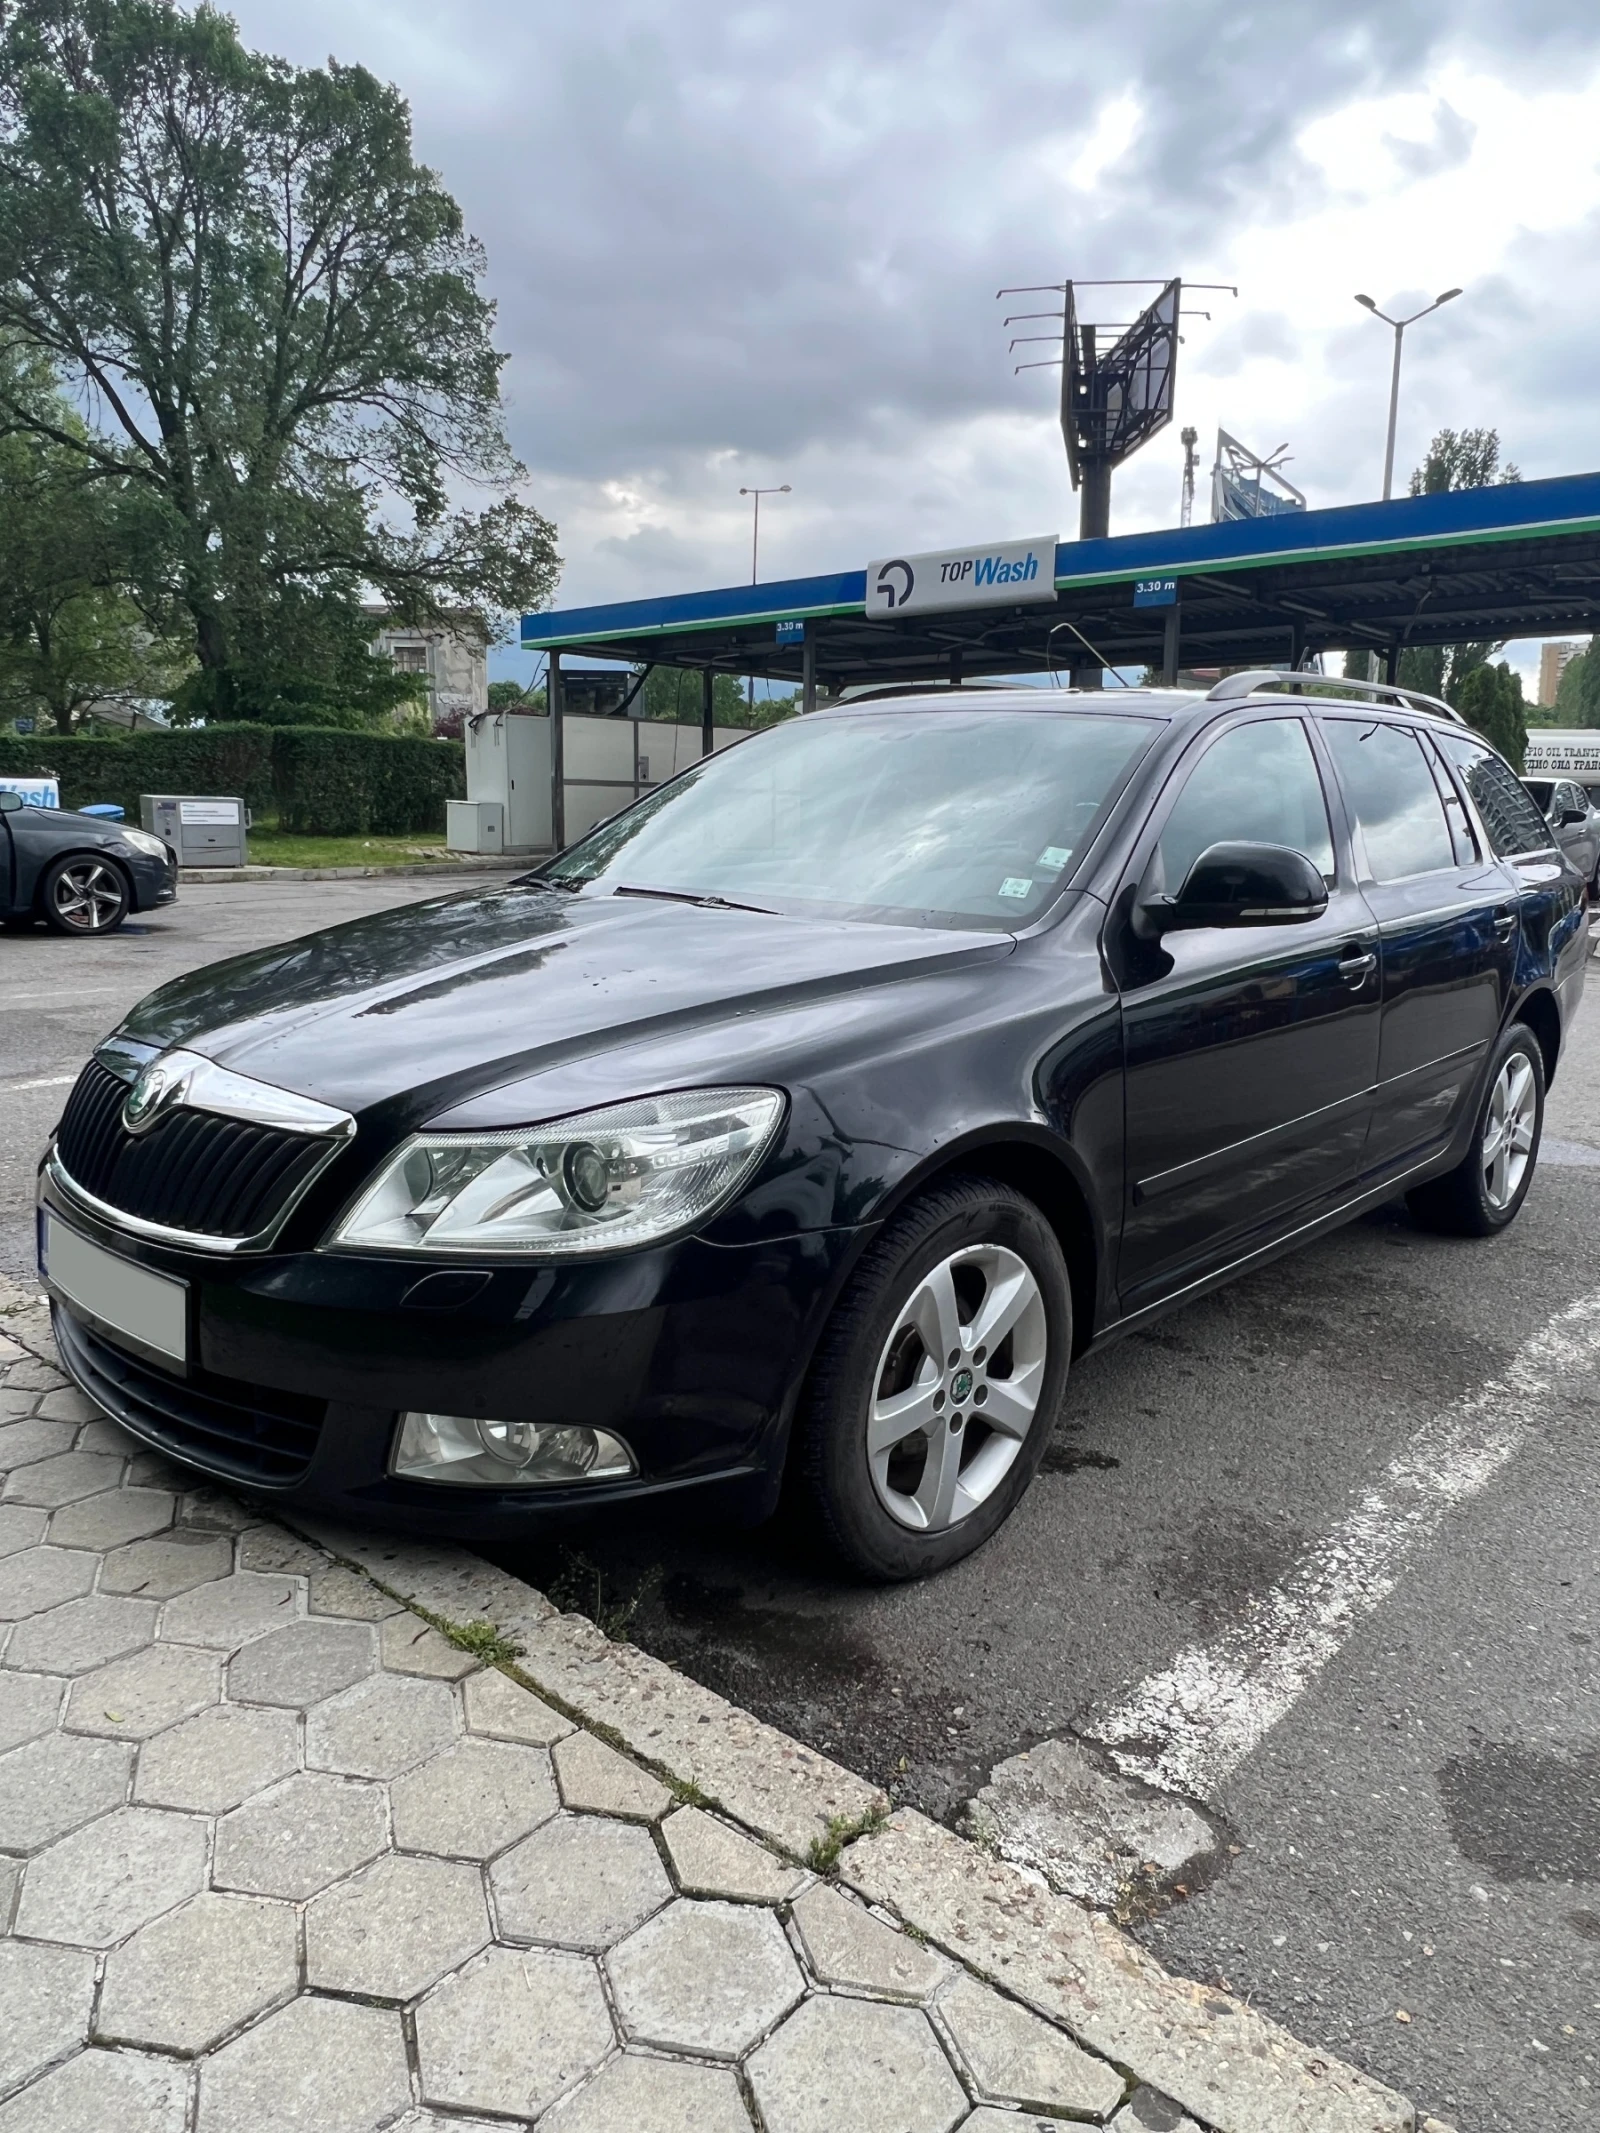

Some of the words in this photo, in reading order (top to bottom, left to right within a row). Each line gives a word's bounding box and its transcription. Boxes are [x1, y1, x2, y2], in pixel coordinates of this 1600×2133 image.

[1136, 581, 1161, 593] 3.30
[1164, 582, 1175, 590] m
[777, 622, 794, 632] 3.30
[795, 622, 804, 630] m
[1546, 748, 1561, 757] OIL
[0, 785, 56, 808] ash
